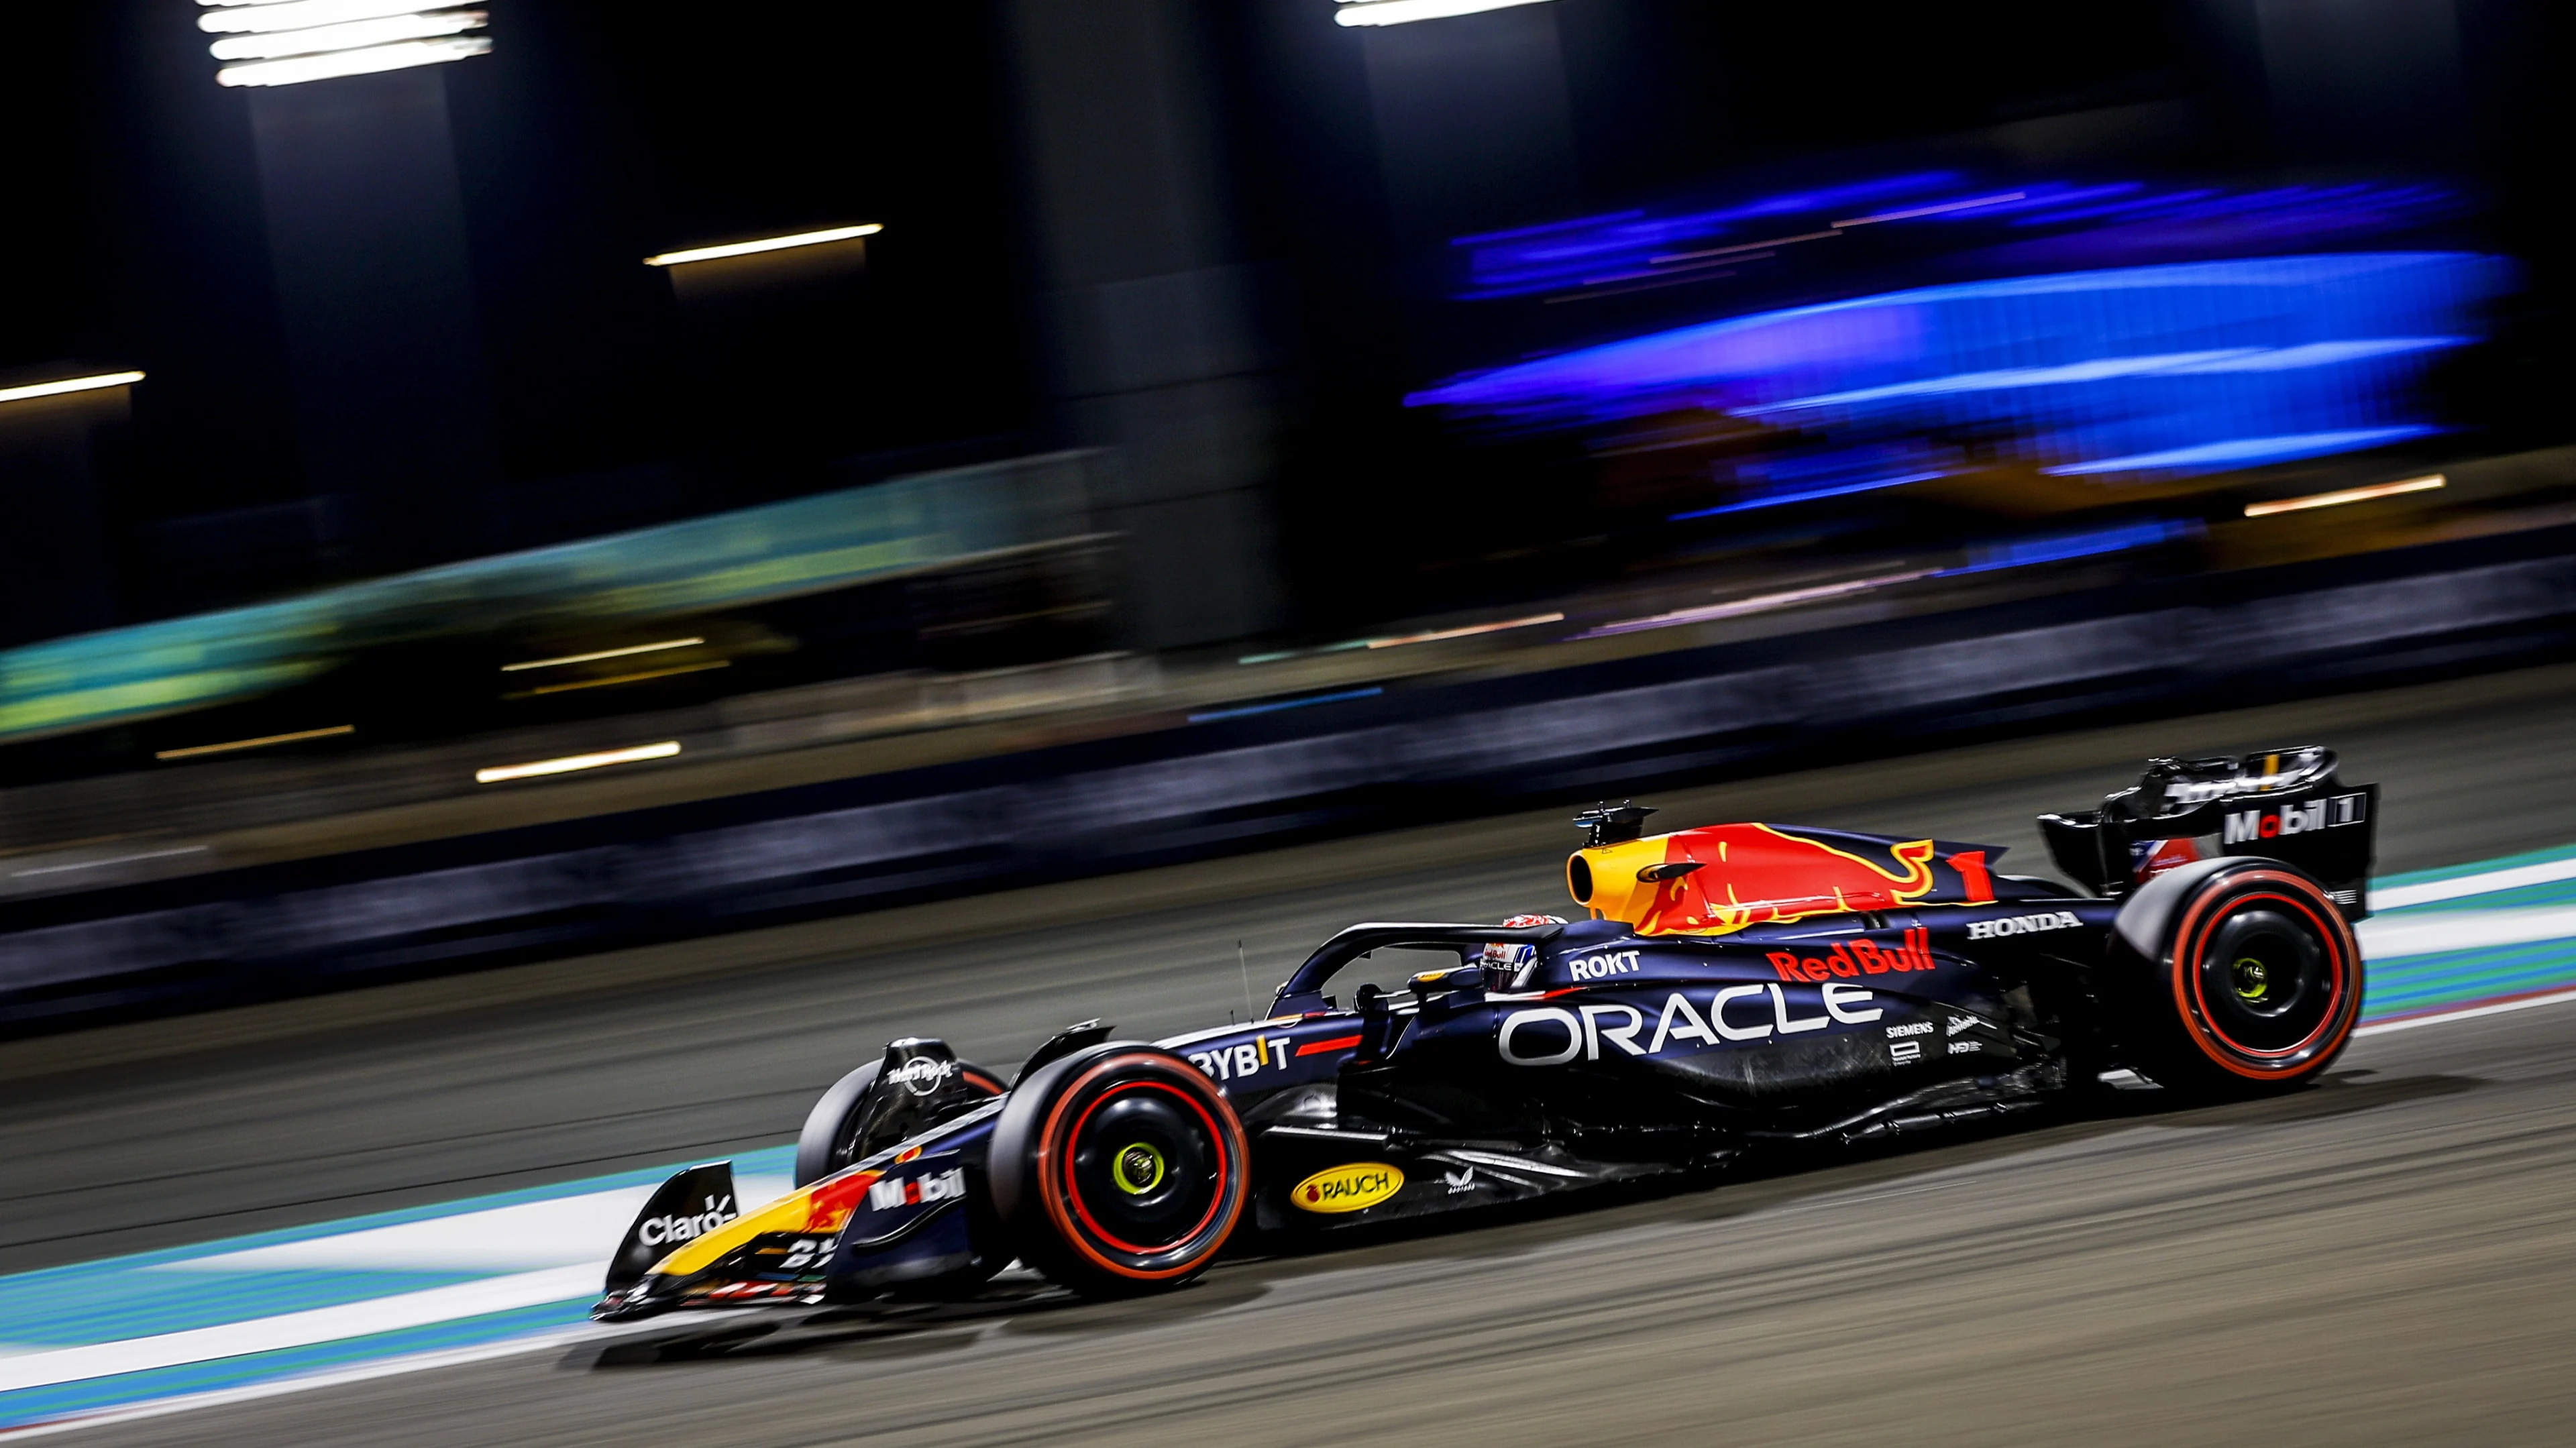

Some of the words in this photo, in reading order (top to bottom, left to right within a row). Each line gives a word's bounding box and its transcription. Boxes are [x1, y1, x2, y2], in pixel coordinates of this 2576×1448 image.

[2224, 799, 2327, 844] Mobil
[2339, 797, 2355, 822] 1
[1945, 851, 1995, 901] 1
[1966, 911, 2084, 940] HONDA
[1569, 950, 1640, 981] ROKT
[1499, 983, 1884, 1066] ORACLE
[1886, 1021, 1934, 1038] SIEMENS
[869, 1167, 967, 1212] Mobil
[1322, 1172, 1389, 1201] RAUCH
[639, 1210, 726, 1247] Claro
